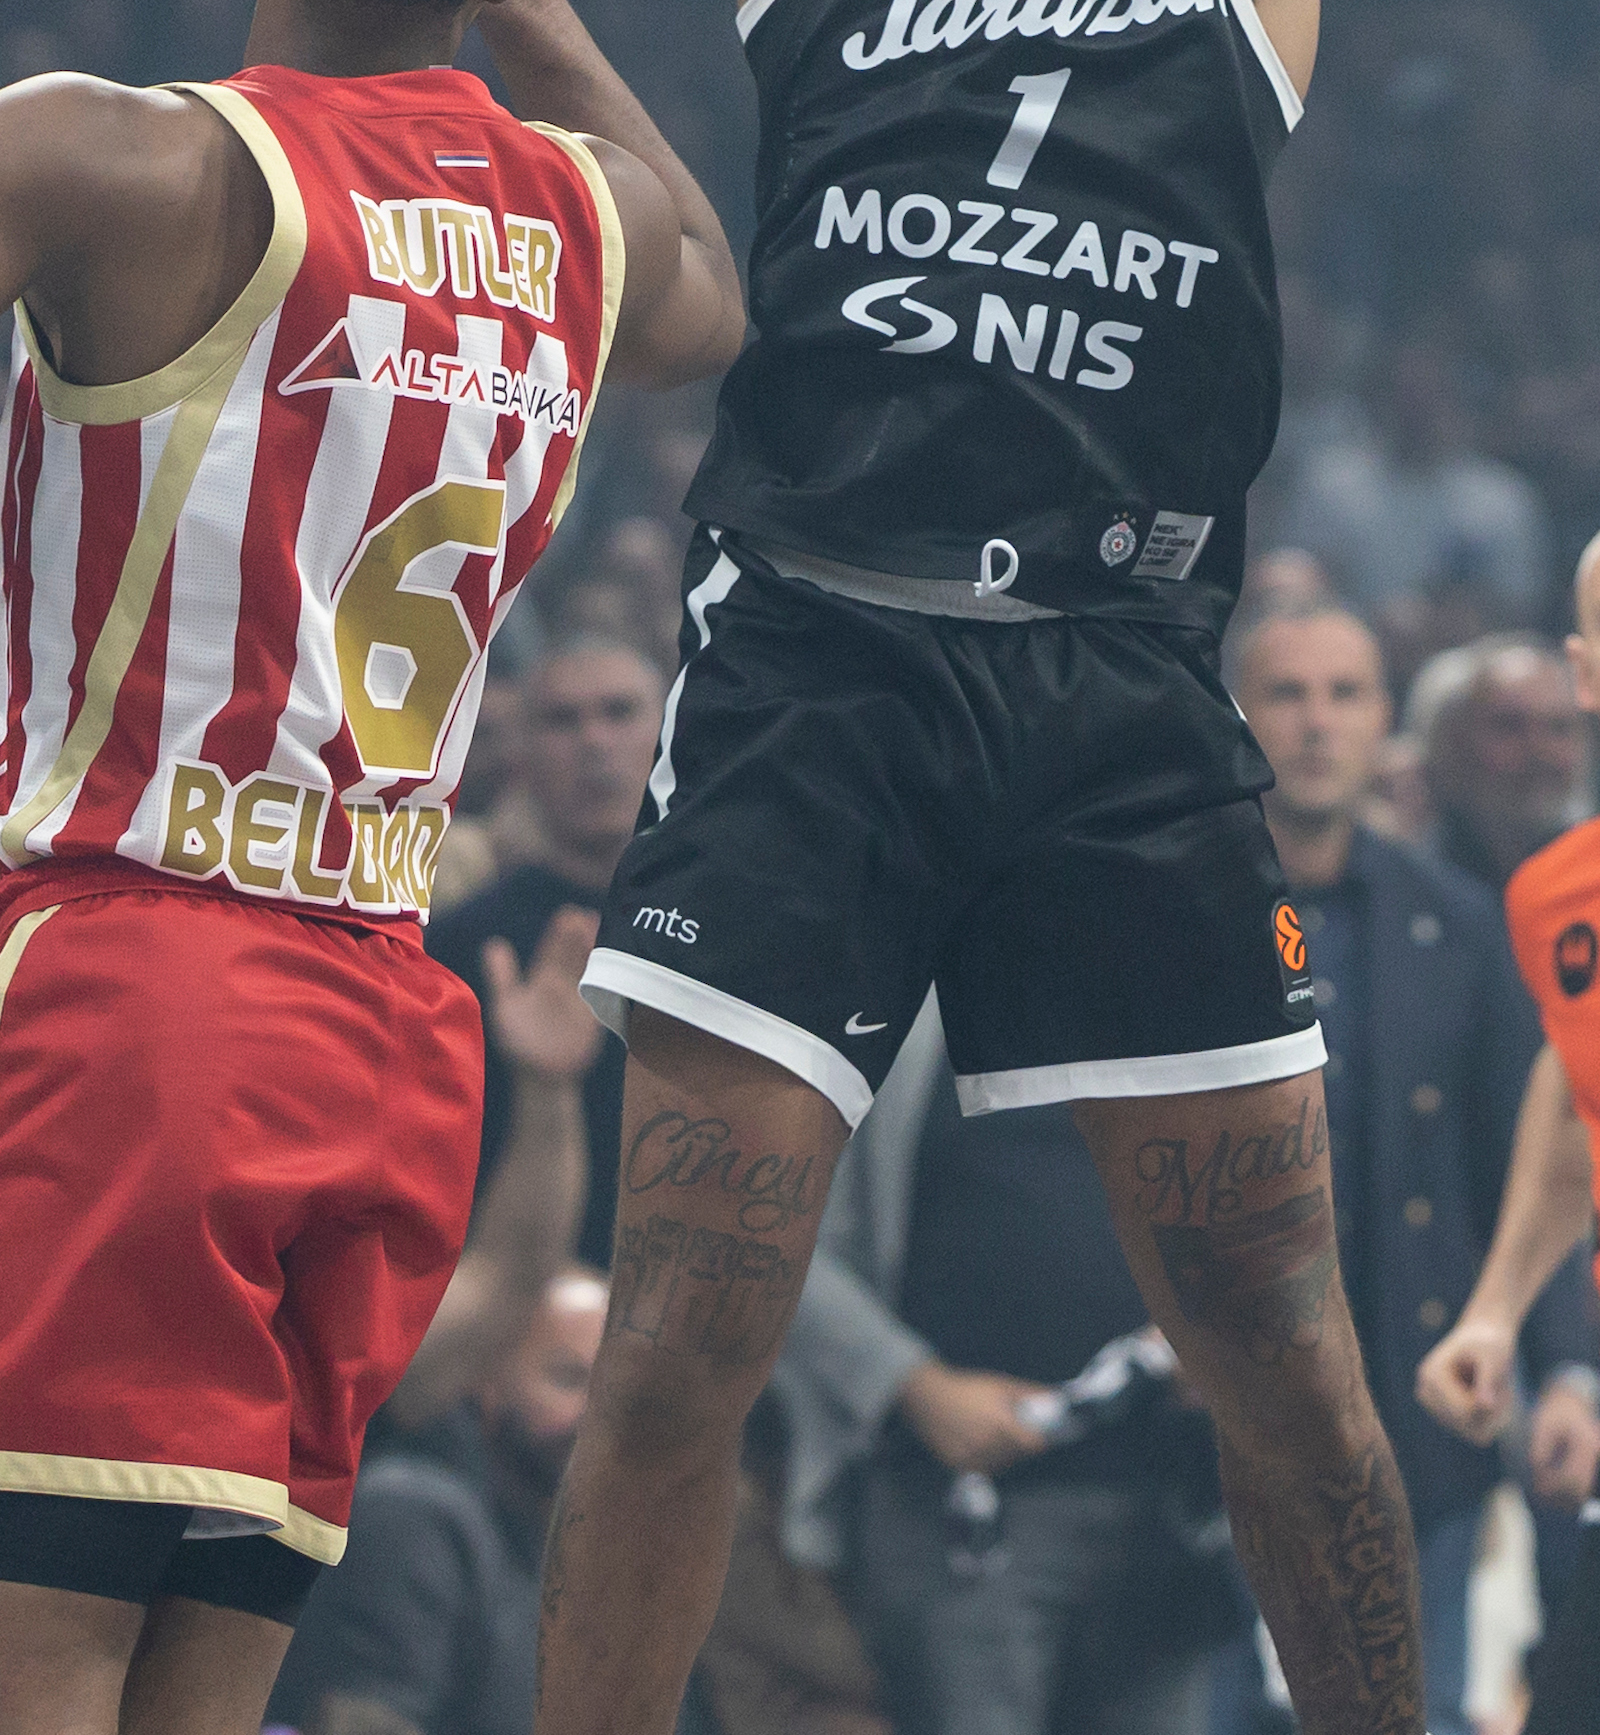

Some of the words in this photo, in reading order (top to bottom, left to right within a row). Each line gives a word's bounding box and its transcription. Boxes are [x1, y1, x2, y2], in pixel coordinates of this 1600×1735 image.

[986, 67, 1072, 190] 1
[351, 190, 560, 323] BUTLER
[814, 185, 1220, 309] MOZZART
[972, 293, 1144, 391] NIS
[330, 473, 508, 779] 6
[632, 907, 700, 944] mts
